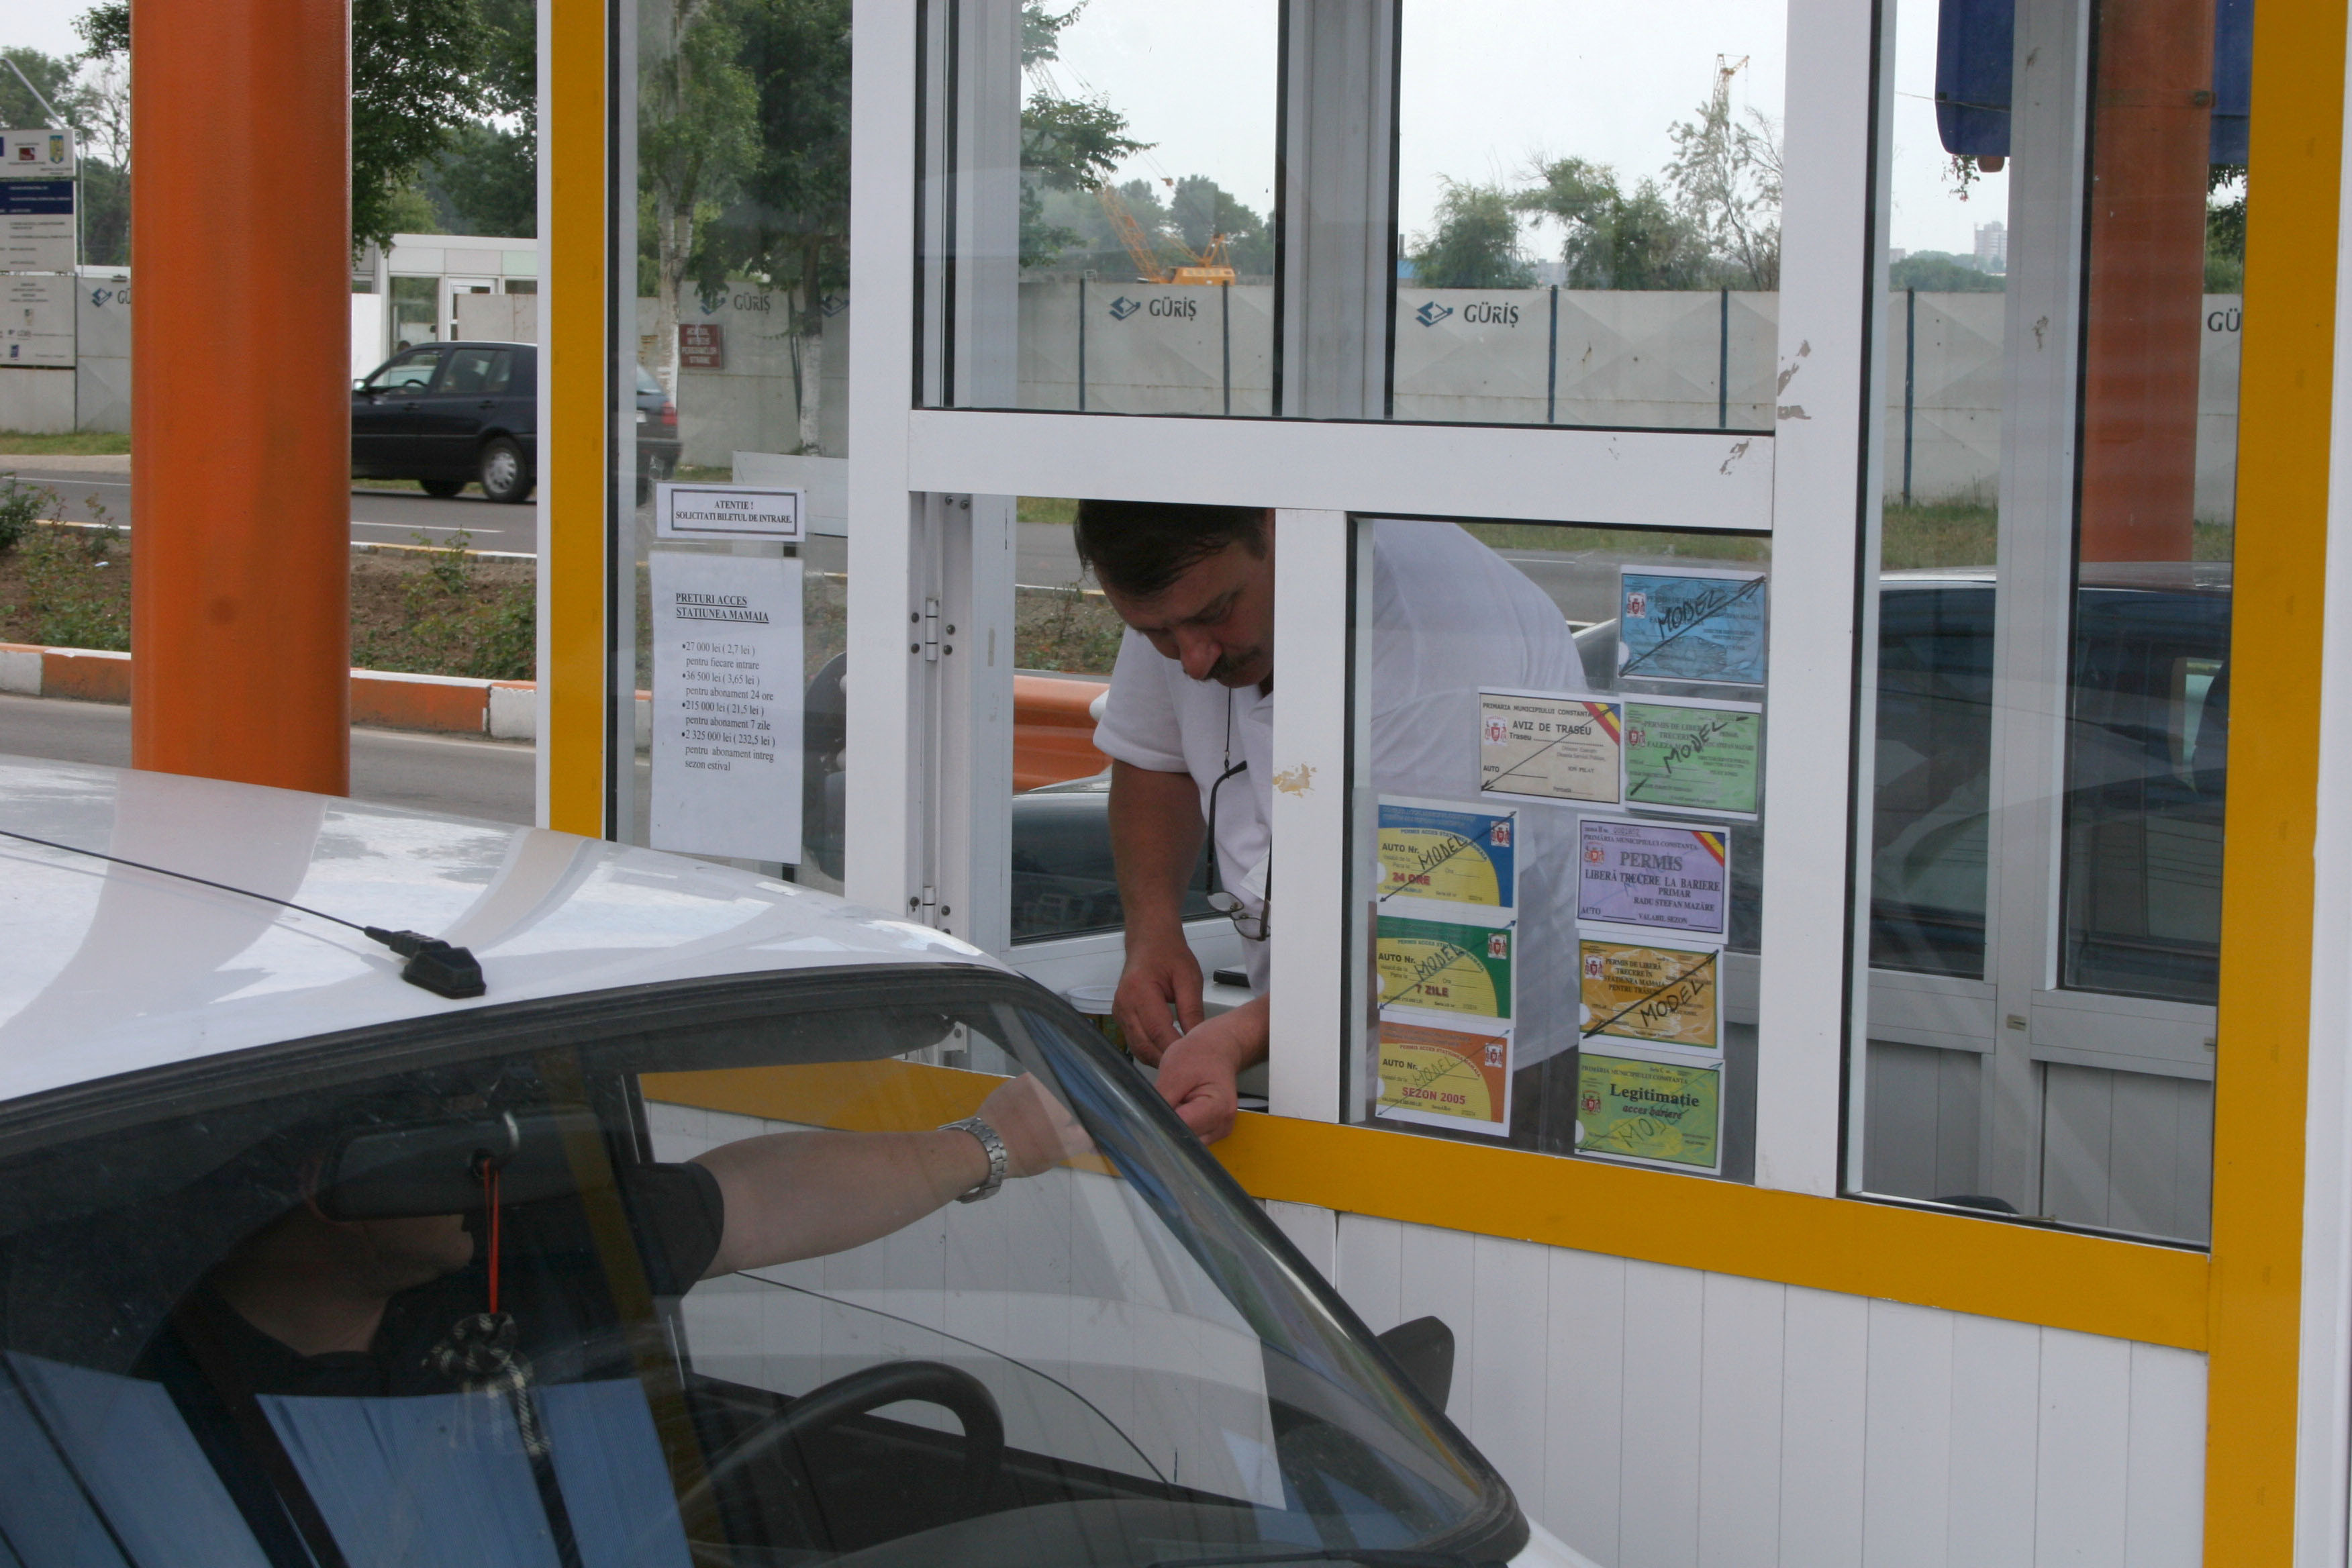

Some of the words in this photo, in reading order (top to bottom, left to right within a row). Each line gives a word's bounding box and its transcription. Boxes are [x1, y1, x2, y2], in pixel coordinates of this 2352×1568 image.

[714, 501, 749, 509] ATENTIE
[676, 513, 716, 521] SOLICITATI
[718, 513, 747, 522] BILETUL
[760, 515, 792, 523] INTRARE.
[676, 593, 714, 604] PRETURI
[718, 595, 747, 605] ACCES
[676, 607, 726, 618] STATIUNEA
[730, 610, 769, 622] MAMAIA
[697, 642, 710, 651] 000
[712, 643, 720, 652] lei
[741, 644, 750, 655] lei
[686, 657, 708, 667] pentru
[711, 657, 734, 668] fiecare
[736, 660, 759, 670] intrare
[697, 673, 710, 681] 500
[712, 673, 720, 683] lei
[728, 674, 743, 684] 3,65
[746, 675, 754, 685] lei
[686, 687, 708, 696] pentru
[710, 687, 748, 699] abonament
[750, 690, 759, 699] 24
[762, 692, 773, 701] ore
[701, 701, 714, 712] 000
[717, 703, 725, 712] lei
[750, 705, 758, 715] lei
[1483, 703, 1510, 711] PRIMARIA
[1514, 705, 1555, 714] MUNICIPIULUI
[686, 716, 707, 726] pentru
[710, 718, 748, 728] abonament
[750, 720, 754, 728] 7
[757, 720, 770, 730] zile
[1513, 721, 1533, 730] AVIZ
[1539, 723, 1551, 732] DE
[1556, 724, 1591, 735] TRASEU
[693, 730, 705, 740] 325
[707, 732, 720, 741] 000
[723, 733, 732, 743] lei
[761, 736, 770, 746] lei
[685, 746, 708, 755] pentru
[712, 746, 751, 758] abonament
[754, 750, 774, 763] intreg
[707, 761, 730, 771] estival
[1382, 843, 1405, 852] AUTO
[1408, 846, 1419, 854] Nr.
[1620, 851, 1683, 871] PERMIS
[1620, 873, 1660, 885] TRECERE
[1665, 877, 1676, 887] LA
[1681, 879, 1720, 891] BARIERE
[1659, 887, 1691, 897] PRIMAR
[1634, 897, 1654, 905] RADU
[1581, 907, 1601, 915] AUTO
[1667, 916, 1687, 924] SEZON
[1378, 953, 1402, 961] AUTO
[1424, 985, 1449, 997] ZILE
[1640, 980, 1704, 1027] MODEL
[1382, 1059, 1404, 1068] AUTO
[1407, 1062, 1418, 1070] Nr.
[1402, 1087, 1437, 1100] SEZON
[1440, 1092, 1466, 1105] 2005
